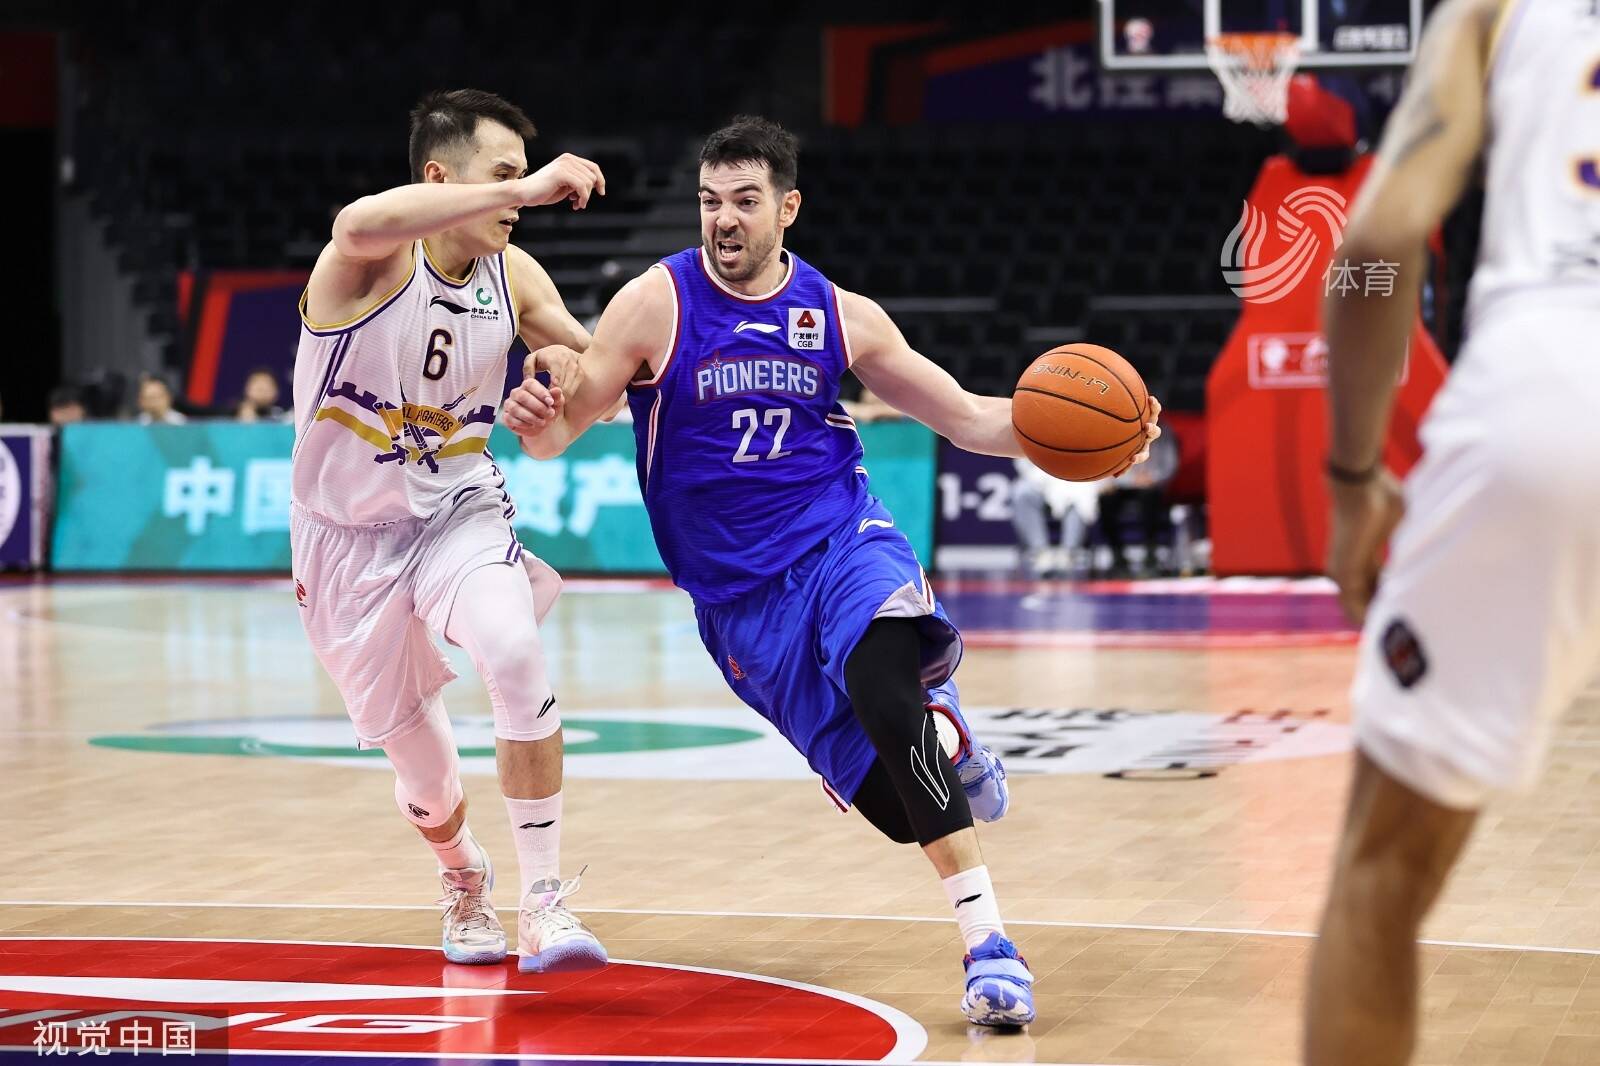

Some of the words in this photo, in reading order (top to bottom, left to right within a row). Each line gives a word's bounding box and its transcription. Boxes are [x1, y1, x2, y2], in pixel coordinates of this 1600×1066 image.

[422, 328, 452, 381] 6
[797, 340, 813, 348] CGB
[1031, 363, 1109, 395] LI-NING
[731, 407, 793, 464] 22
[163, 455, 292, 535] 中国
